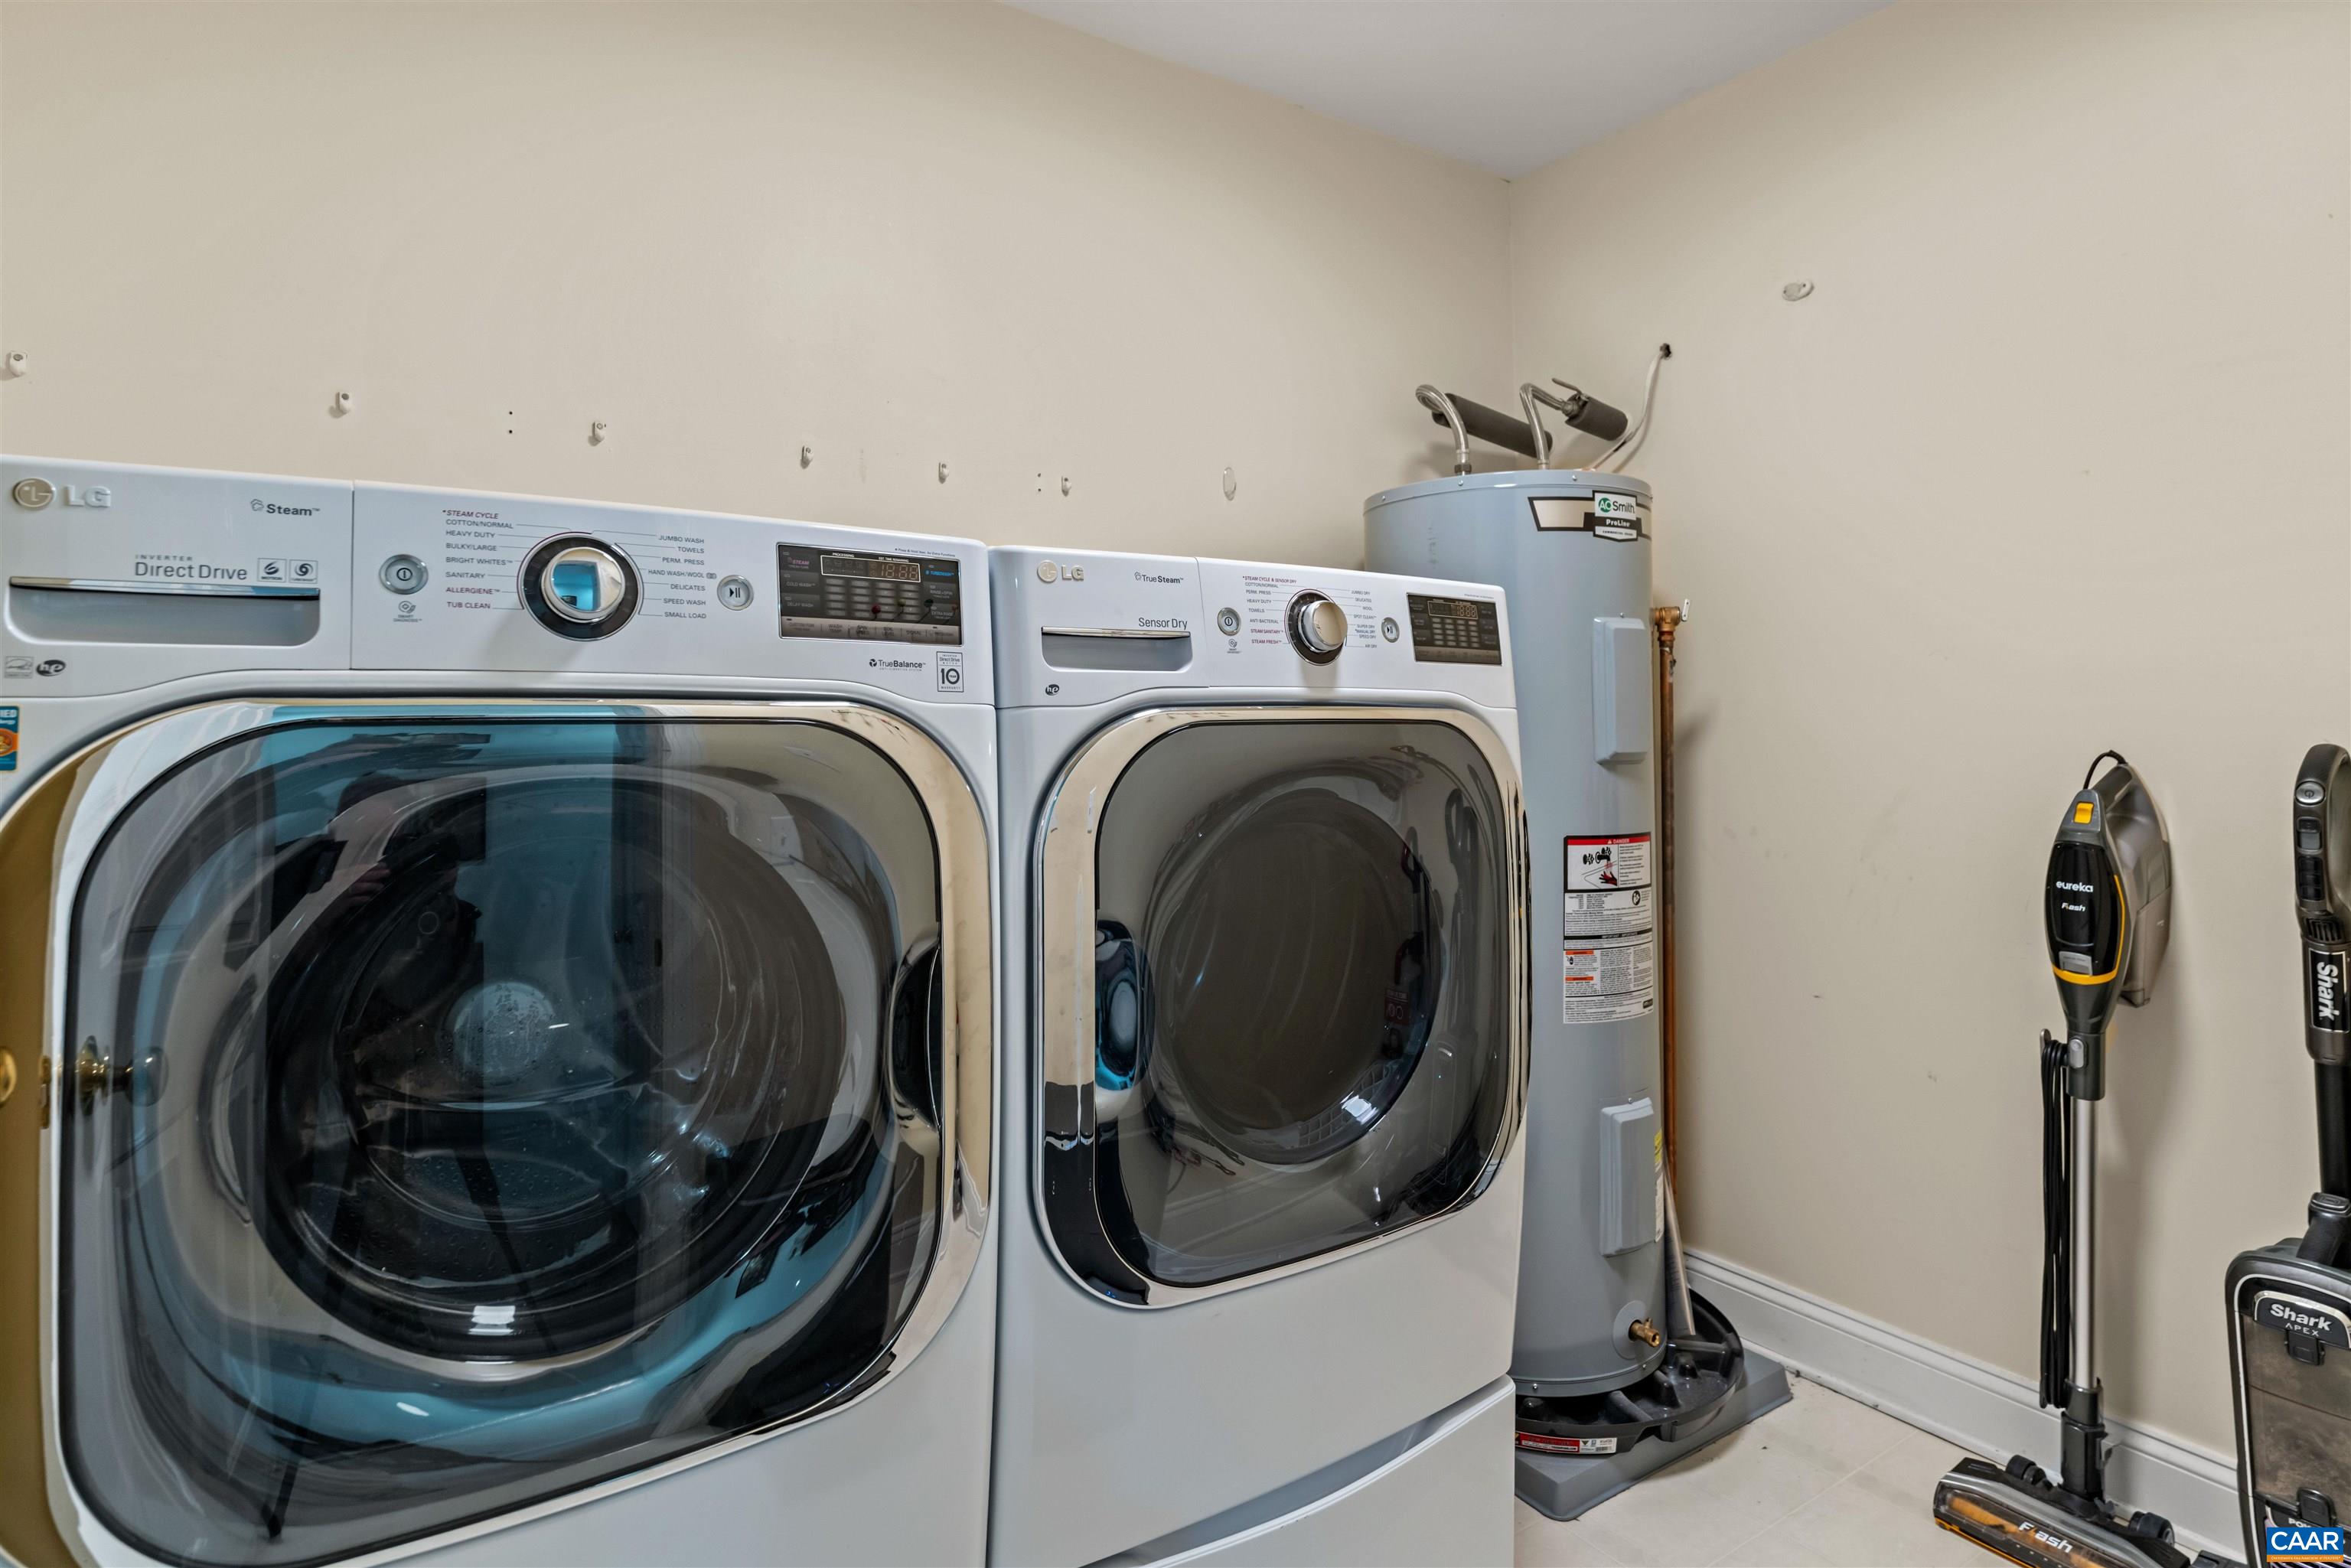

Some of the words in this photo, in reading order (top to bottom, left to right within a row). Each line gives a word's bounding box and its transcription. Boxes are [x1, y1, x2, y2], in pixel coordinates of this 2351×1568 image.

[65, 485, 112, 508] LG
[1612, 500, 1635, 514] Smith
[446, 519, 514, 529] COTTON/NORMAL
[1606, 518, 1631, 527] ProLine
[446, 543, 497, 551] BULKY/LARGE
[135, 562, 194, 579] Direct
[198, 565, 248, 580] Drive
[1061, 565, 1084, 581] LG
[1139, 618, 1169, 628] Sensor
[1172, 618, 1188, 631] Dry
[941, 668, 960, 684] 10
[2056, 880, 2094, 893] eureka
[2317, 961, 2340, 1021] Shark
[2270, 1303, 2332, 1332] Shark
[2285, 1322, 2320, 1337] APEX
